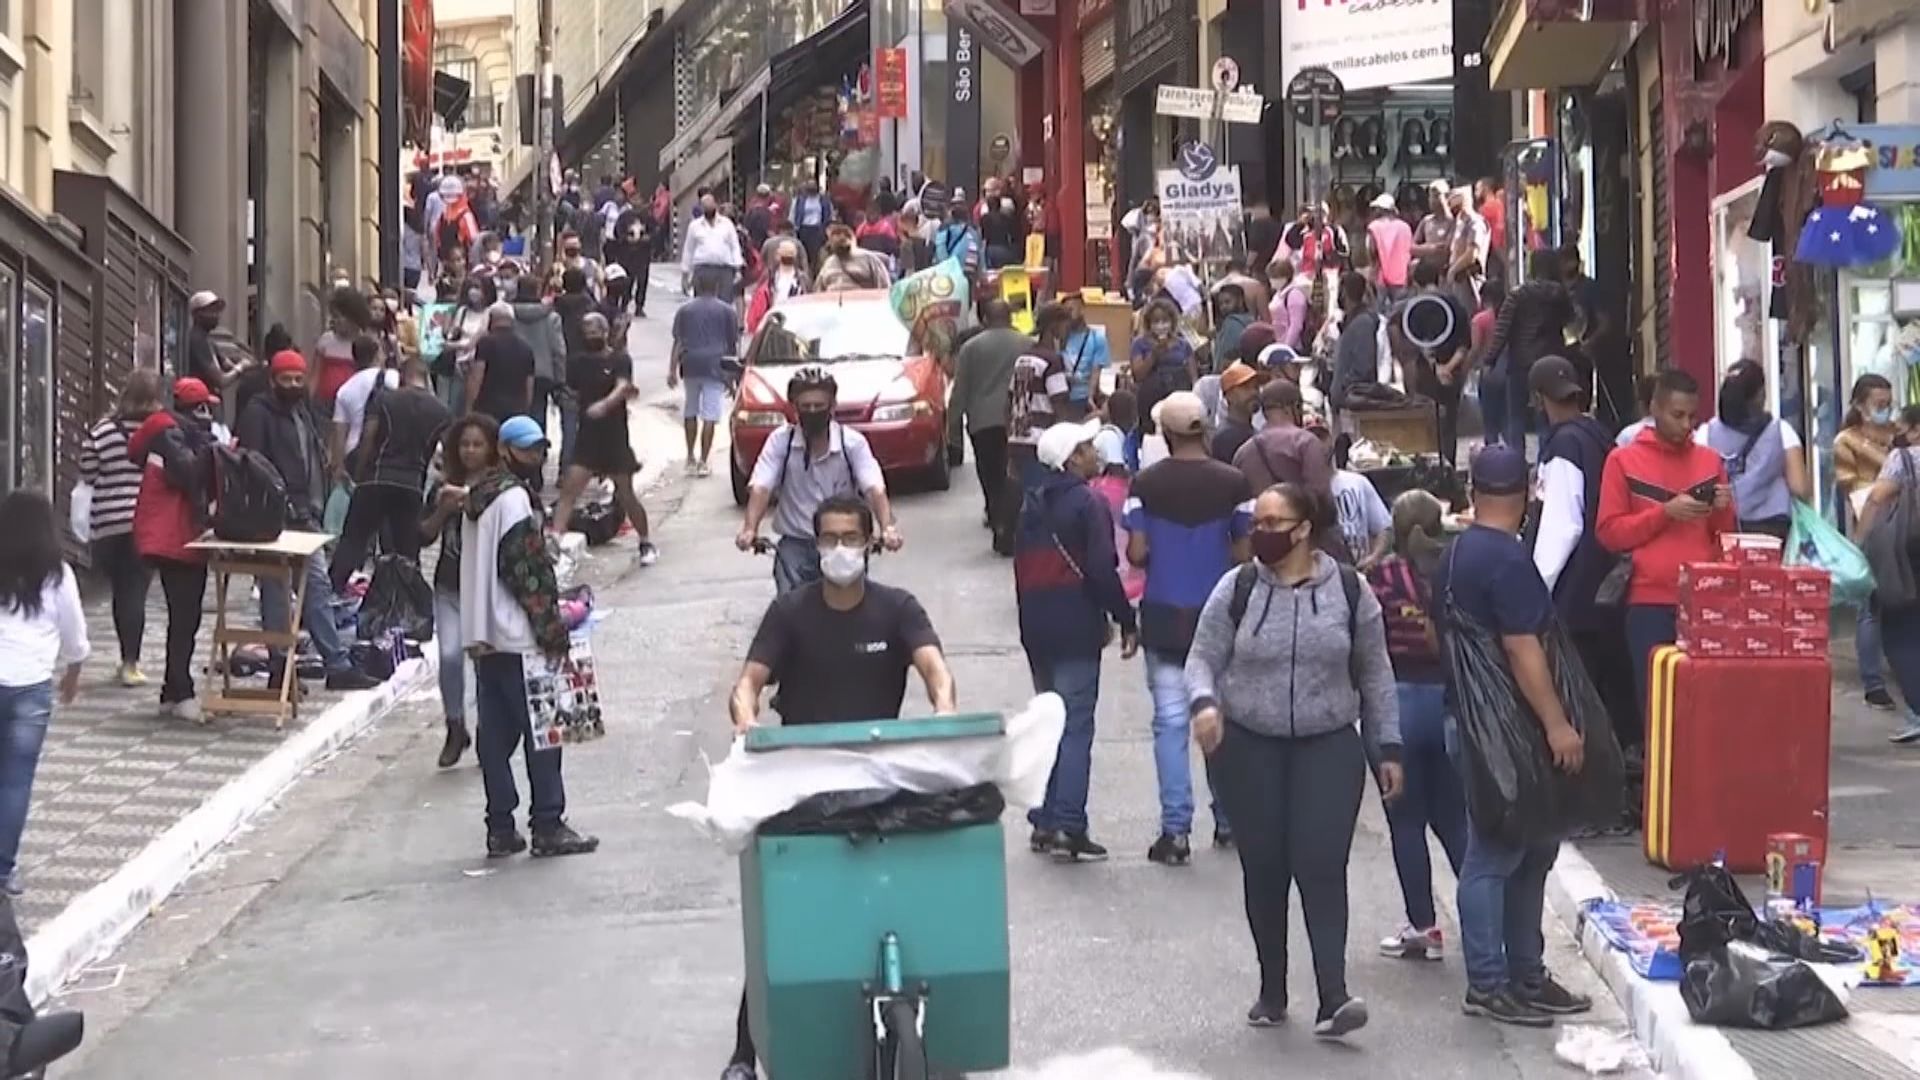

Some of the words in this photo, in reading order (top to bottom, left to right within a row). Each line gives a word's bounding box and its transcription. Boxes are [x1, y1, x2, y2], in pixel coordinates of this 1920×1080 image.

[1463, 53, 1481, 67] 85
[955, 67, 971, 102] São
[1165, 182, 1234, 199] Gladys
